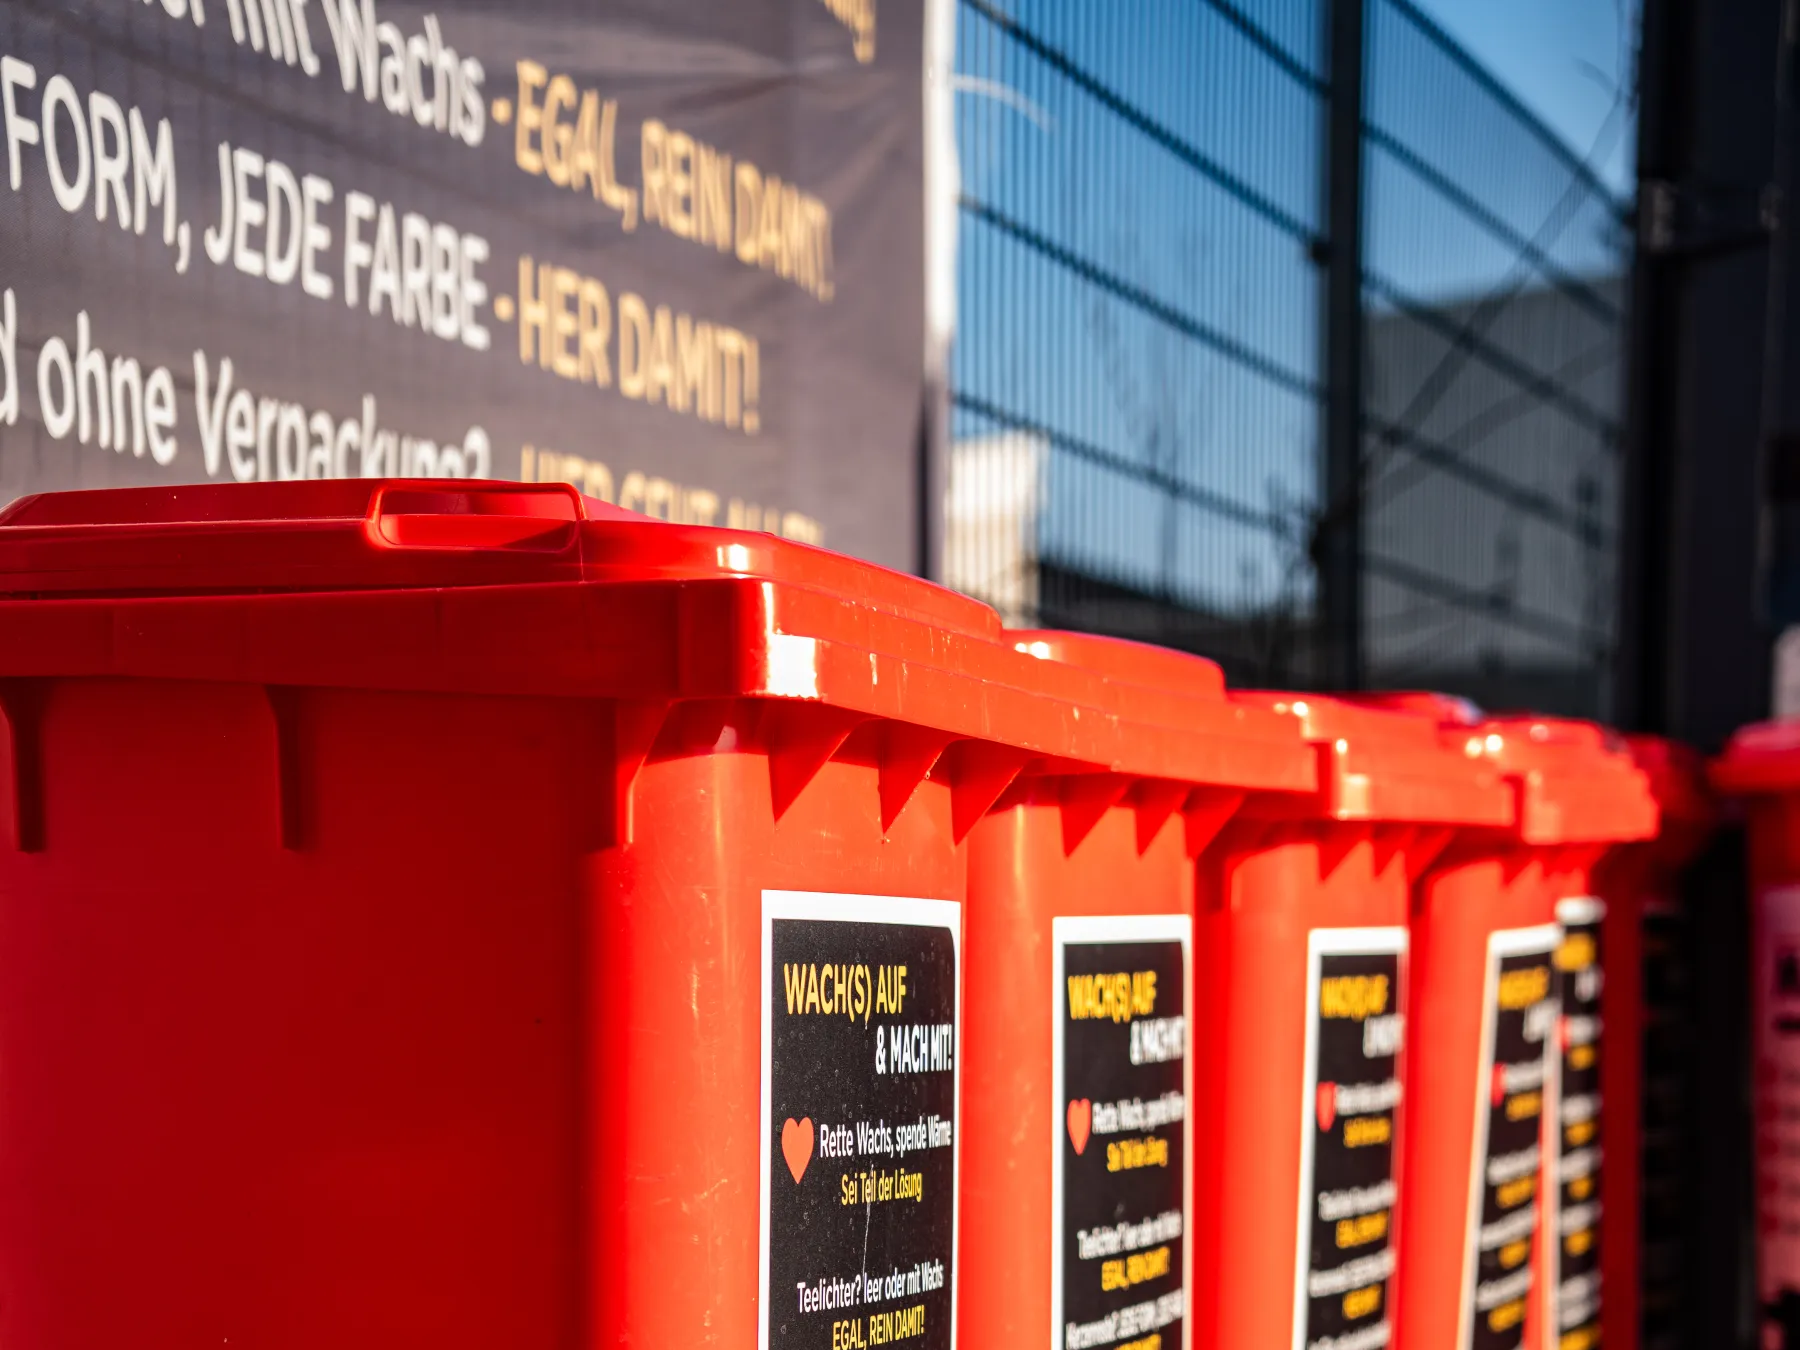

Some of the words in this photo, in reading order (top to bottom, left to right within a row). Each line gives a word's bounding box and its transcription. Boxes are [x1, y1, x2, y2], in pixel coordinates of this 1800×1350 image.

[515, 58, 638, 233] EGAL,
[640, 118, 732, 254] REIN
[1, 54, 191, 275] FORM,
[204, 140, 334, 300] JEDE
[343, 190, 491, 351] FARBE
[518, 254, 612, 389] HER
[617, 291, 761, 436] DAMIT!
[37, 310, 178, 466] ohne
[784, 963, 872, 1022] WACH(S)
[876, 965, 907, 1014] AUF
[875, 1025, 886, 1075] &
[890, 1024, 928, 1075] MACH
[930, 1023, 952, 1072] MIT!
[820, 1123, 854, 1158] Rette
[857, 1119, 894, 1158] Wachs,
[896, 1116, 926, 1158] spende
[841, 1172, 858, 1206] Sei
[860, 1170, 876, 1204] Teil
[878, 1169, 893, 1202] der
[895, 1167, 922, 1203] Lösung
[797, 1274, 861, 1313] Teelichter?
[863, 1272, 883, 1304] leer
[885, 1266, 906, 1300] oder
[907, 1263, 921, 1296] mit
[921, 1258, 944, 1292] Wachs
[869, 1312, 893, 1346] REIN
[895, 1304, 925, 1341] DAMIT!
